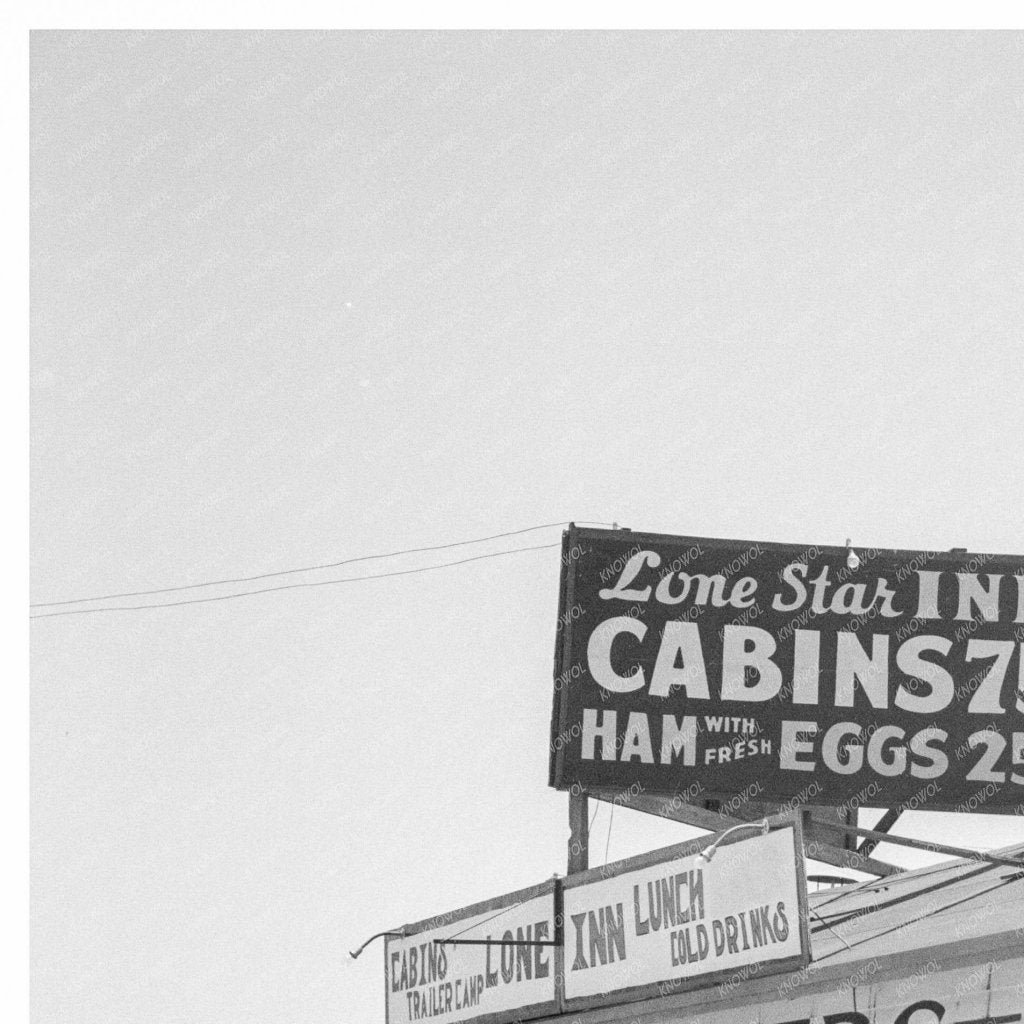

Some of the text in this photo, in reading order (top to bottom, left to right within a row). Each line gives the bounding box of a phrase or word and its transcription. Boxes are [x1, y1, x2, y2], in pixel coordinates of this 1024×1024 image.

[599, 550, 758, 608] Lone
[772, 562, 903, 618] Star
[587, 616, 956, 714] CABINS
[581, 708, 697, 766] HAM
[780, 720, 950, 780] EGGS
[704, 715, 756, 735] WITH
[704, 738, 772, 766] FRESH
[633, 868, 705, 937] LUNCH
[671, 901, 790, 968] COLD DRINKS
[391, 942, 448, 993] CABINS
[485, 902, 626, 989] LONE INN
[406, 974, 485, 1022] TRAILER CAMP
